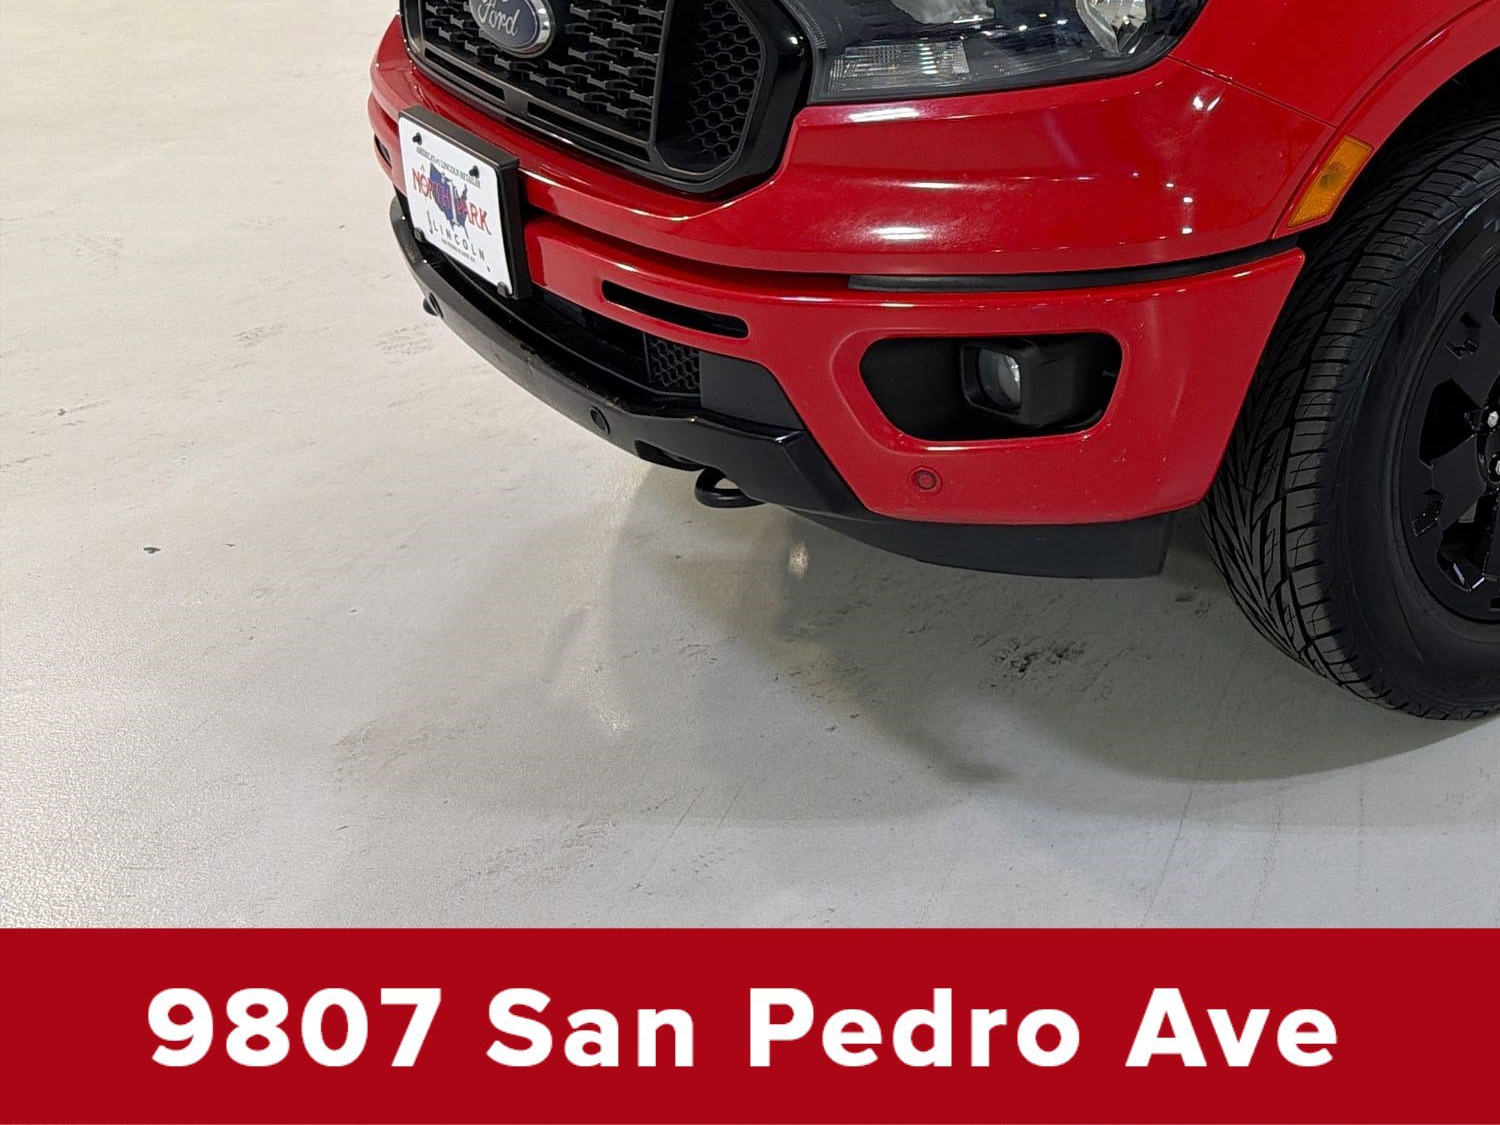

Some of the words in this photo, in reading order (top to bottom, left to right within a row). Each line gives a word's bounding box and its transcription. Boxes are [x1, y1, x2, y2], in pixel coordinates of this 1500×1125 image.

[411, 166, 451, 207] NORTH
[456, 193, 492, 236] PARK
[433, 219, 486, 262] LINCOLN
